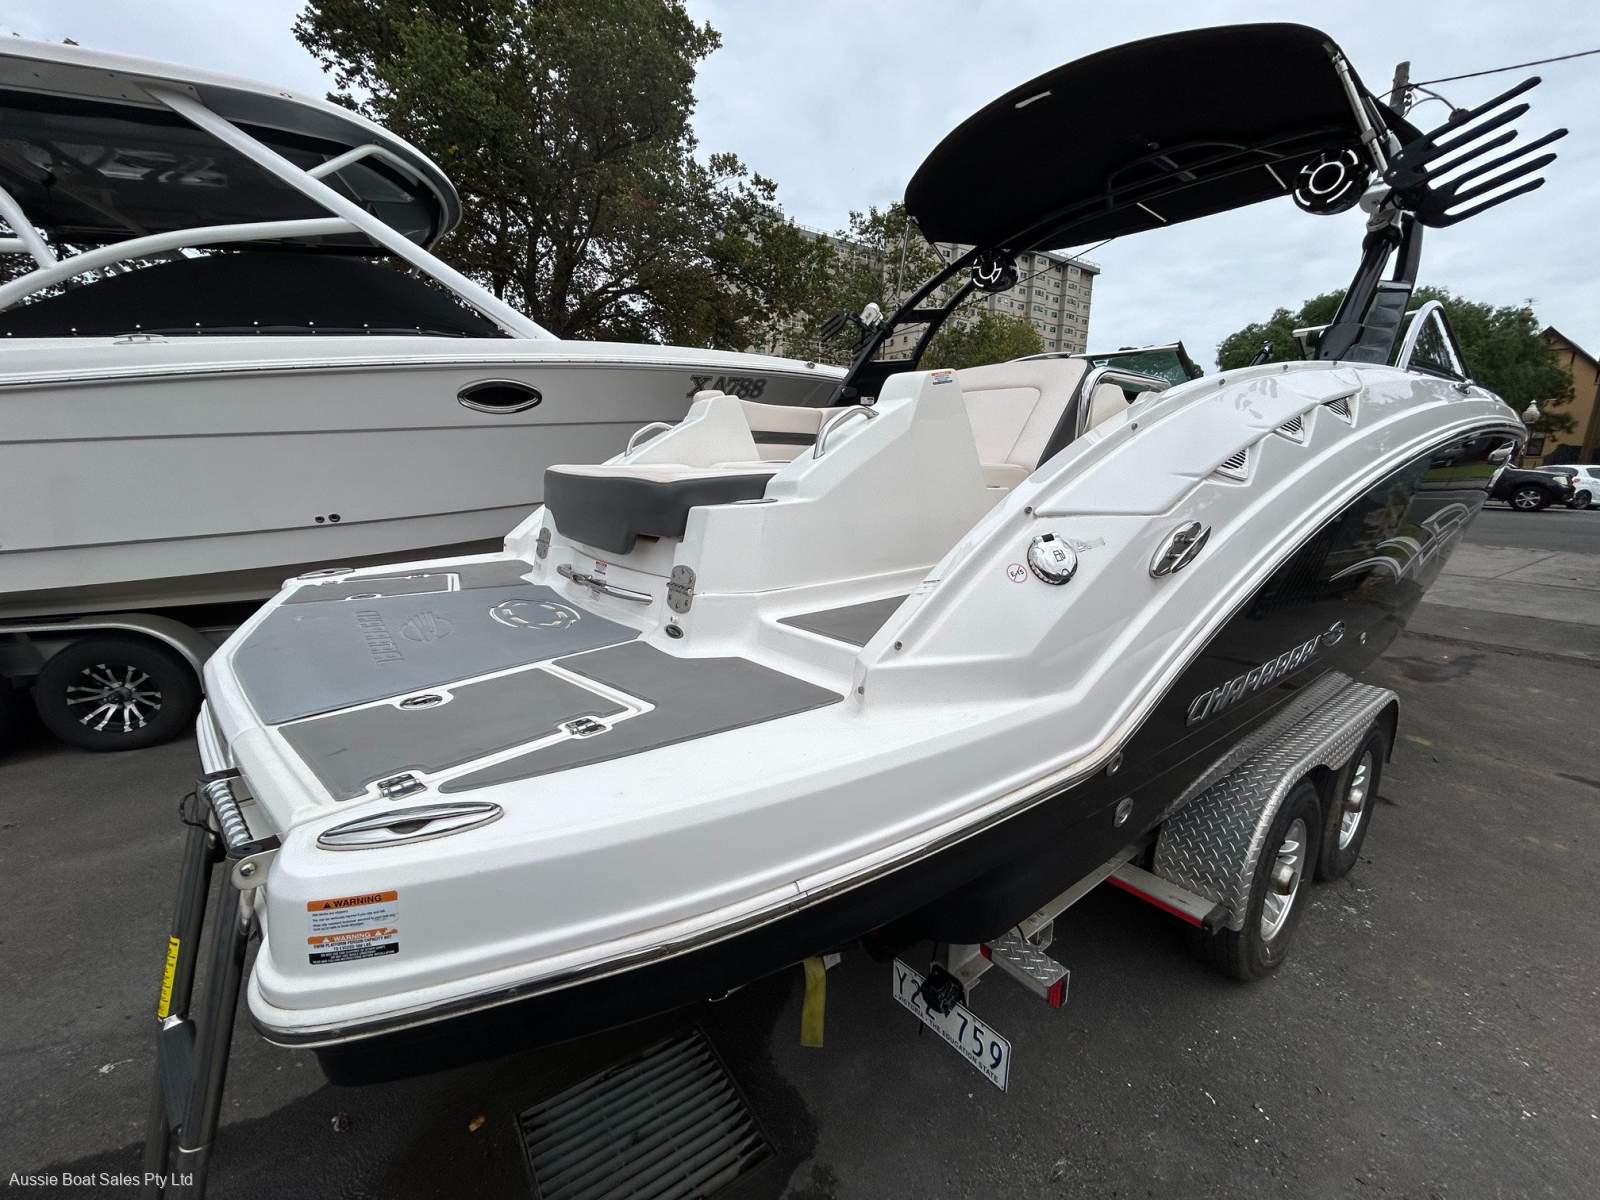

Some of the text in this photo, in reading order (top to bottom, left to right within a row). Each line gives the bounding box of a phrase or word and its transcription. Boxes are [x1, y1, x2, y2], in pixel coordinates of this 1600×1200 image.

[1185, 634, 1319, 726] CHAPARRAL
[333, 894, 382, 908] WARNING
[333, 931, 372, 943] WARNING
[942, 1030, 977, 1063] EDUCATION
[979, 1062, 999, 1083] STATE
[957, 1012, 1003, 1070] 759
